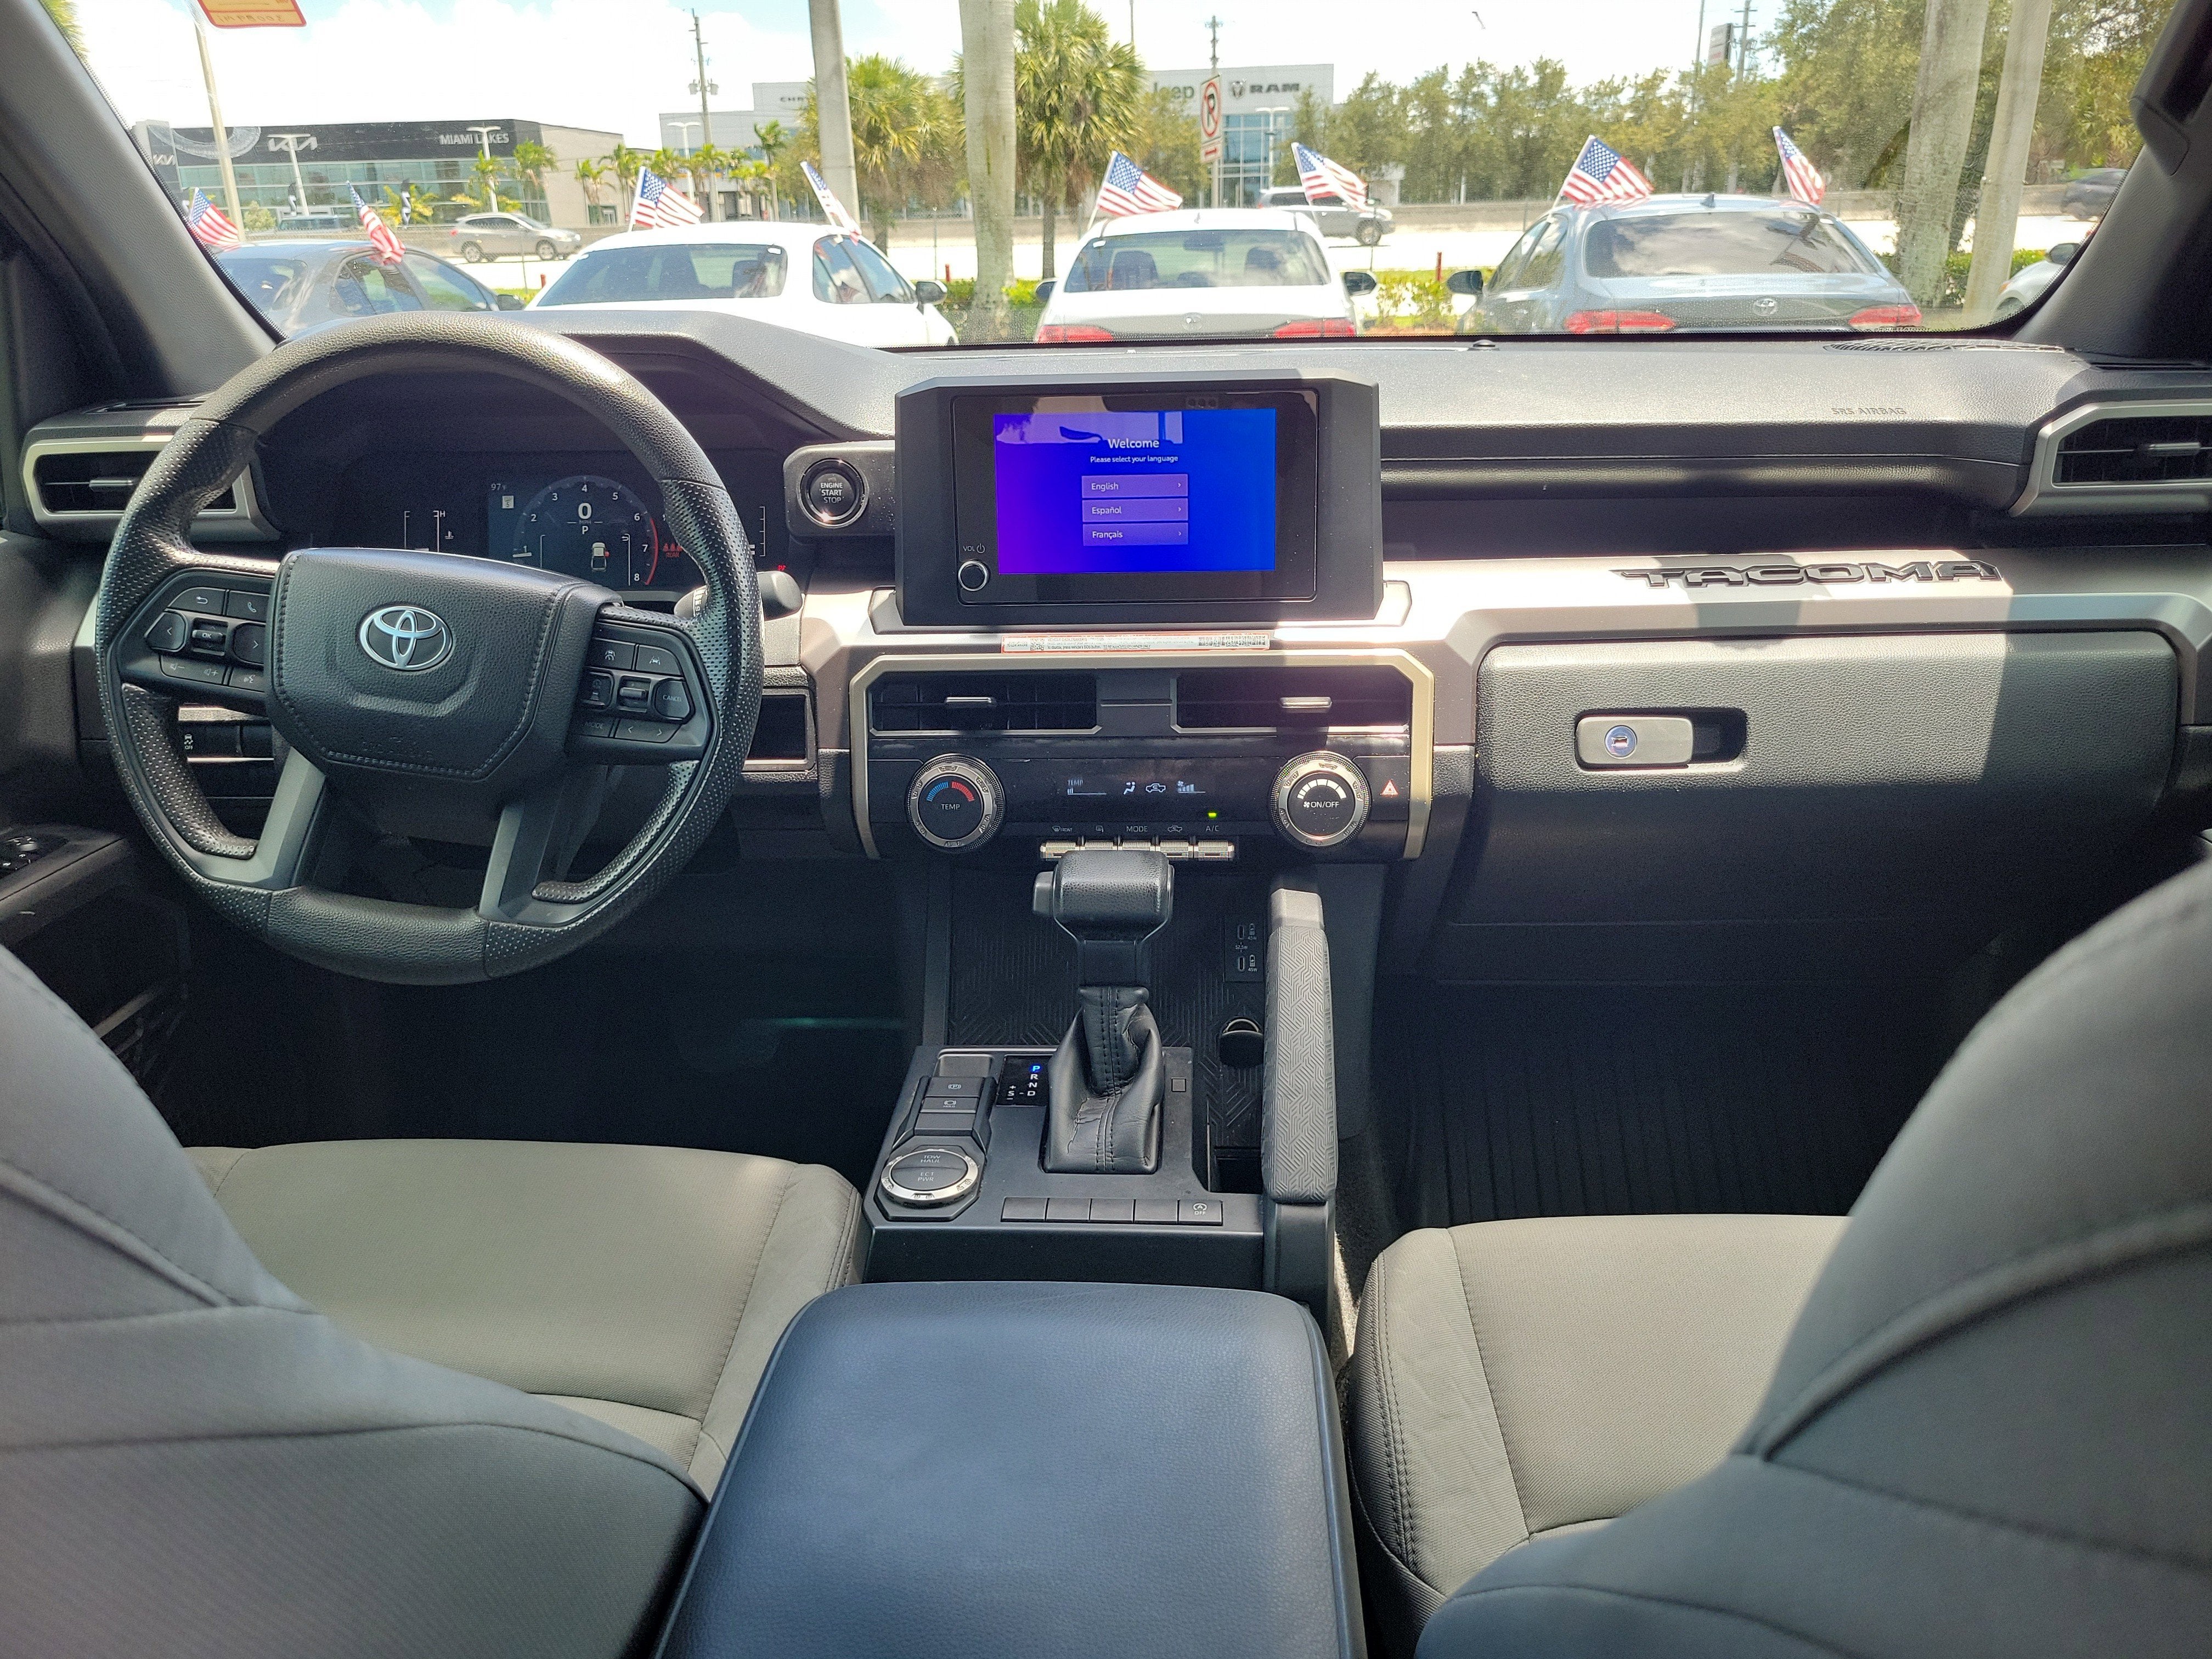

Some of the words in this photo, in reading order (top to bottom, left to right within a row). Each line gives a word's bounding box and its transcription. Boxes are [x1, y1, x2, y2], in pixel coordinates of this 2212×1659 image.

[1250, 83, 1299, 93] RAM
[439, 134, 473, 144] MIAMI
[474, 133, 510, 144] LKES
[1108, 438, 1160, 448] Welcome
[1147, 455, 1178, 463] language
[1091, 482, 1119, 492] English
[552, 493, 558, 501] 3
[578, 503, 592, 520] 0
[1092, 506, 1121, 516] Español
[582, 526, 589, 534] P
[1092, 531, 1123, 540] Français
[1610, 561, 2002, 588] TACOMA
